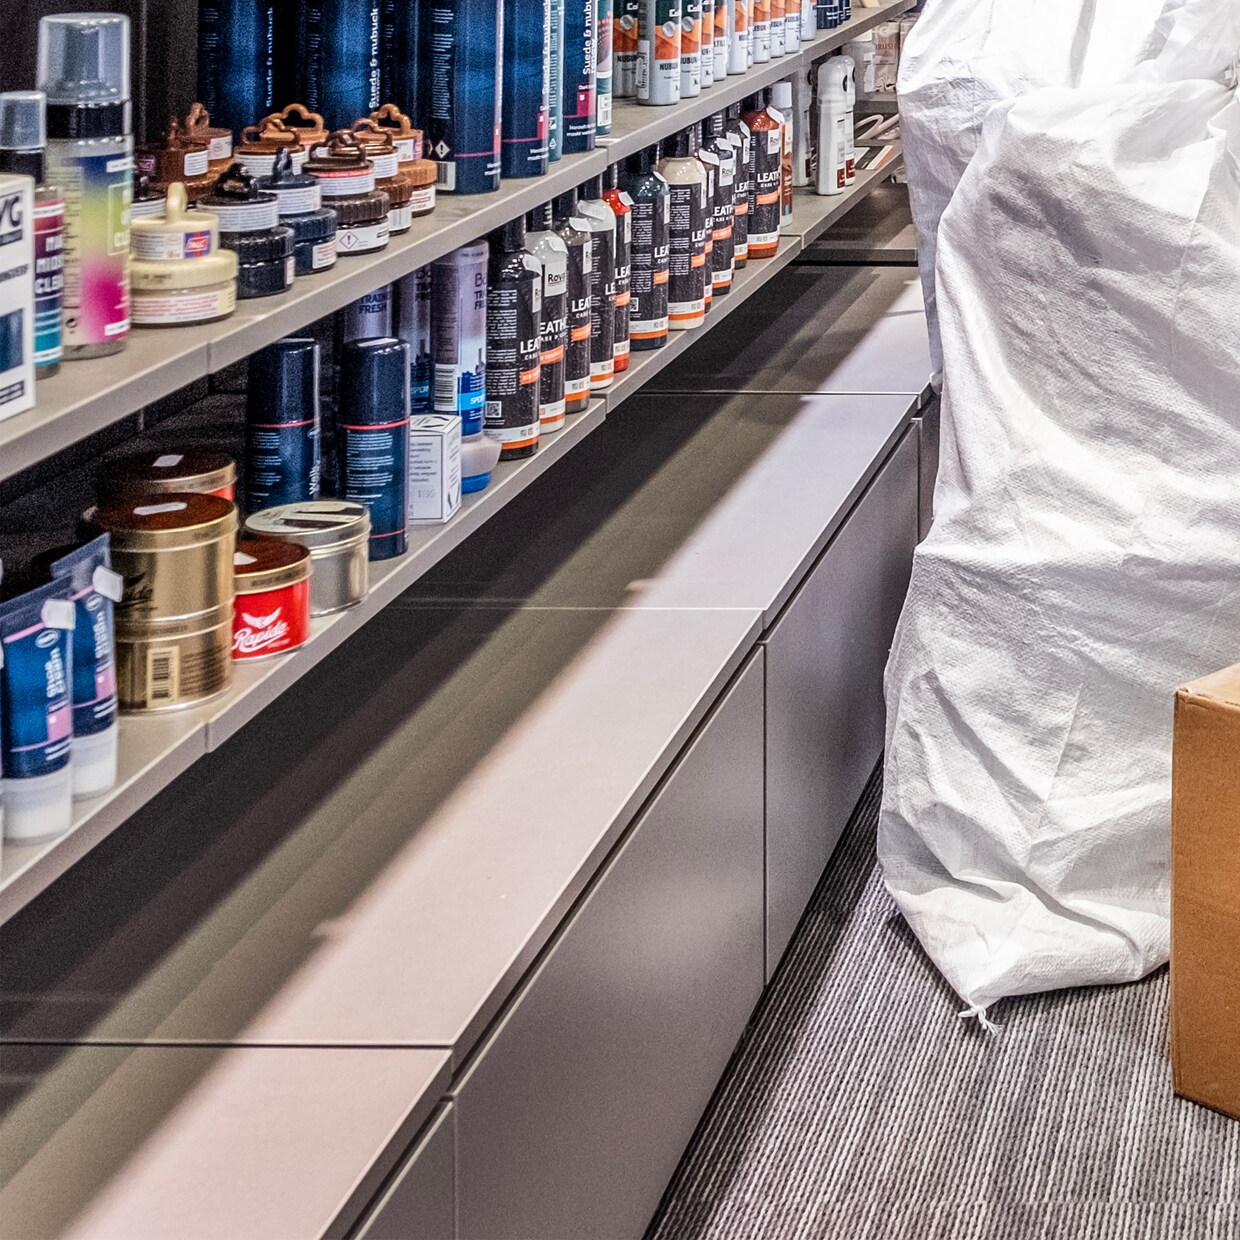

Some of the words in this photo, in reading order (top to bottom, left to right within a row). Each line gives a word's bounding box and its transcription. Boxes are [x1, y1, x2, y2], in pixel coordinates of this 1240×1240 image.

[370, 7, 379, 53] nubuck
[583, 40, 592, 75] Suede
[368, 72, 378, 109] Suede
[231, 619, 289, 653] Rapide
